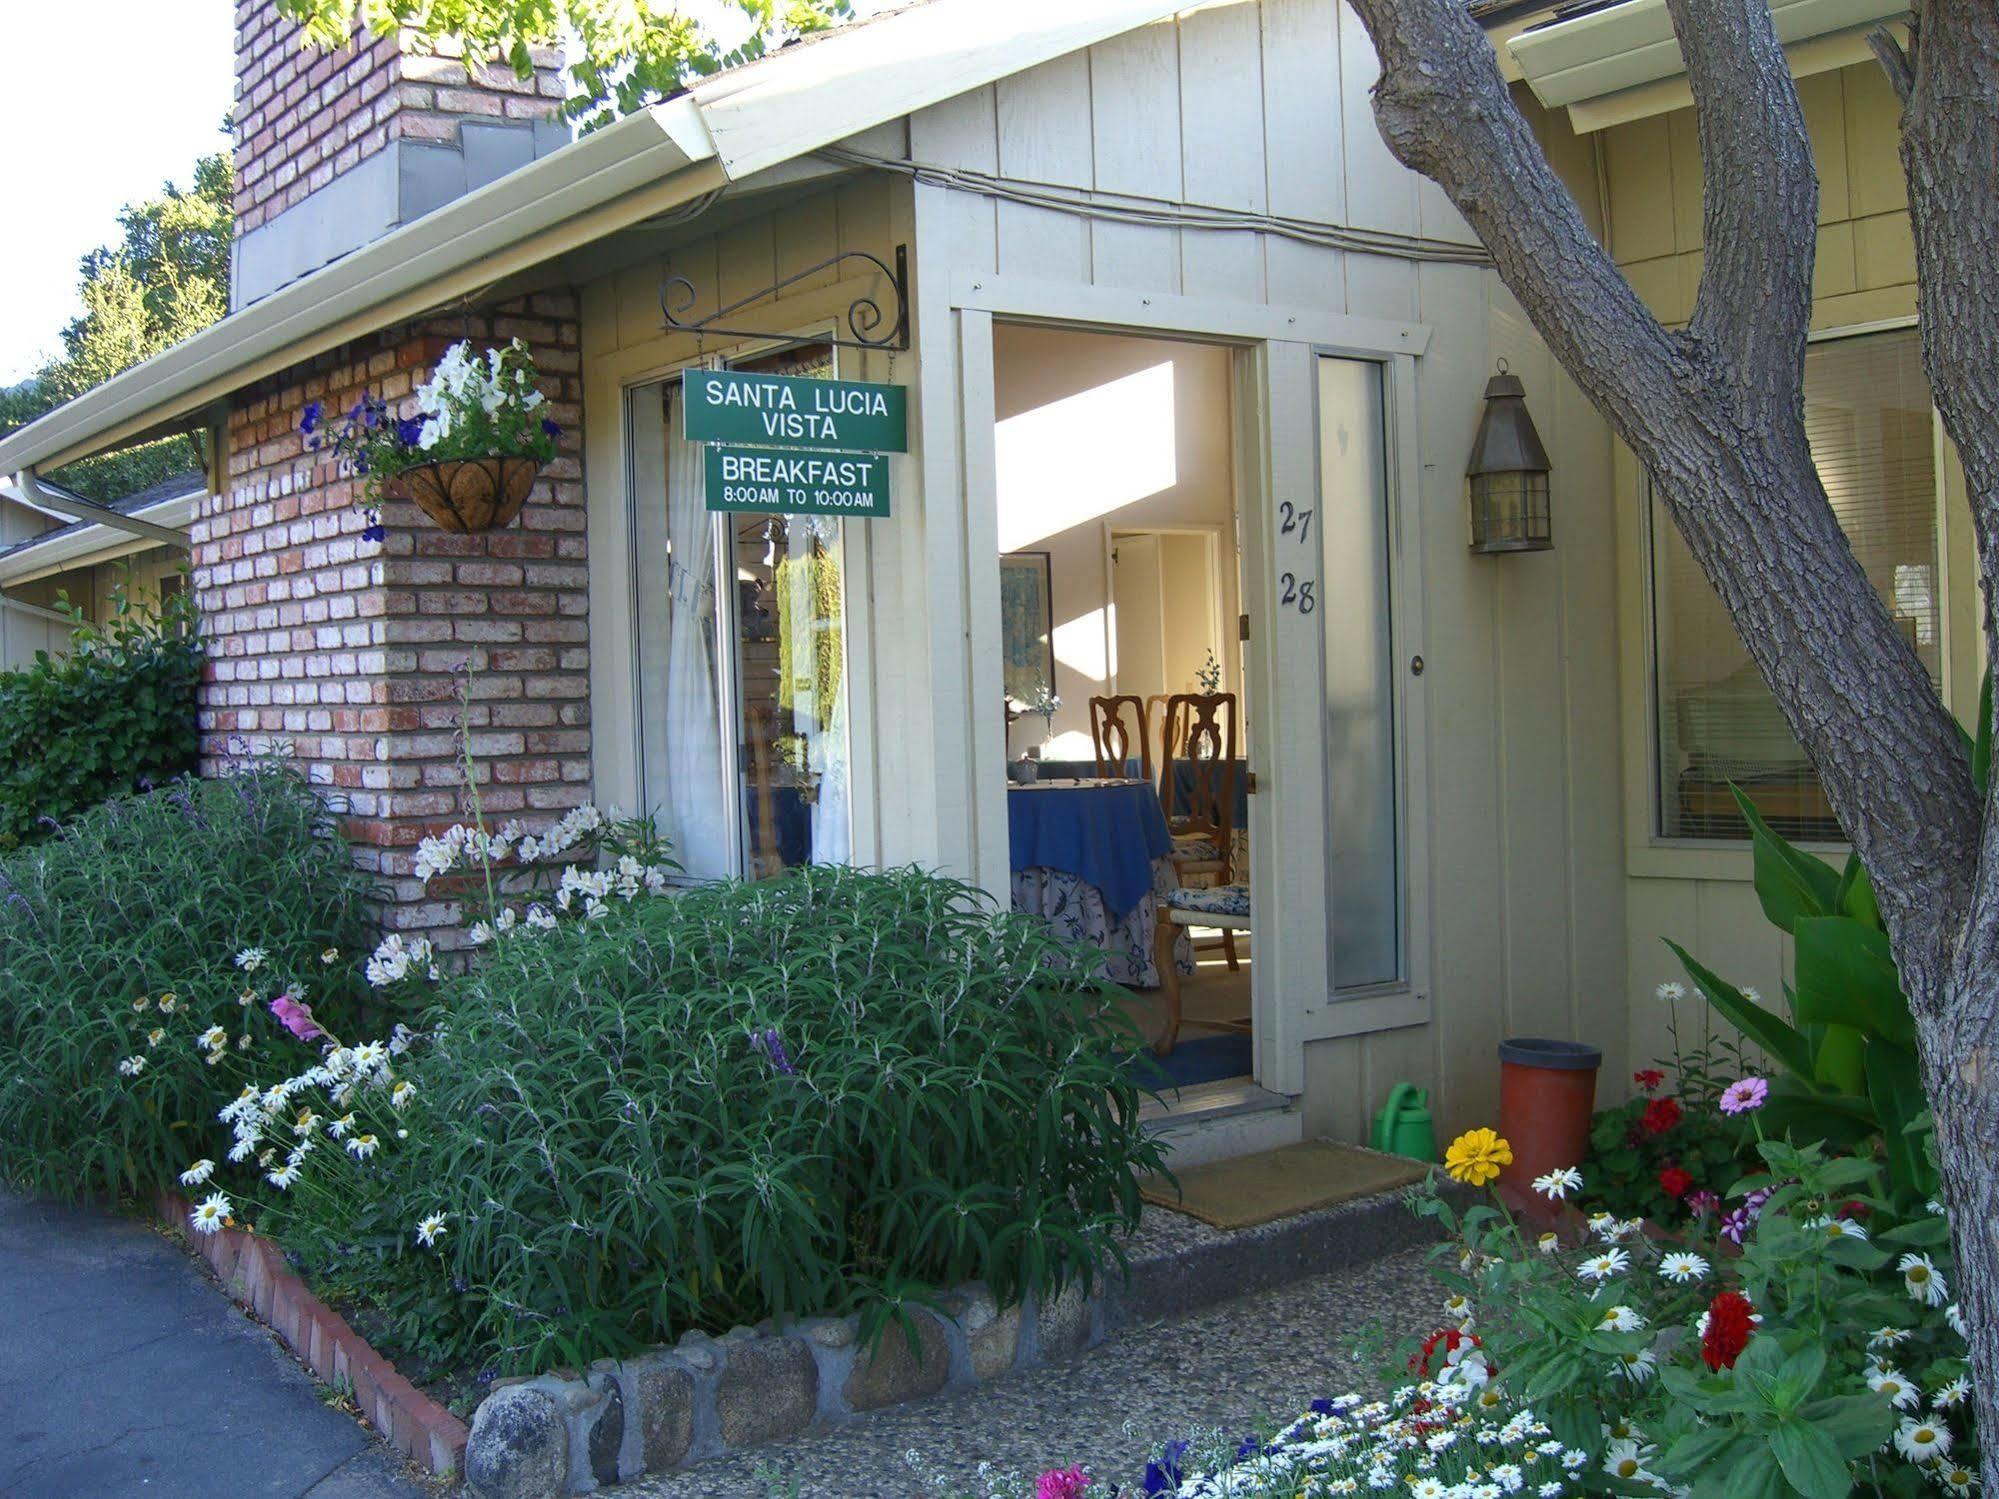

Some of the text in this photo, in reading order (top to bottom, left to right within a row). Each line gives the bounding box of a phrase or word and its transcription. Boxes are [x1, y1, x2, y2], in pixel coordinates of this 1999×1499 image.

[706, 380, 888, 416] SANTA LUCIA
[762, 412, 837, 439] VISTA
[722, 456, 872, 486] BREAKFAST
[787, 489, 806, 504] TO
[1280, 501, 1312, 544] 27
[1281, 572, 1314, 614] 28
